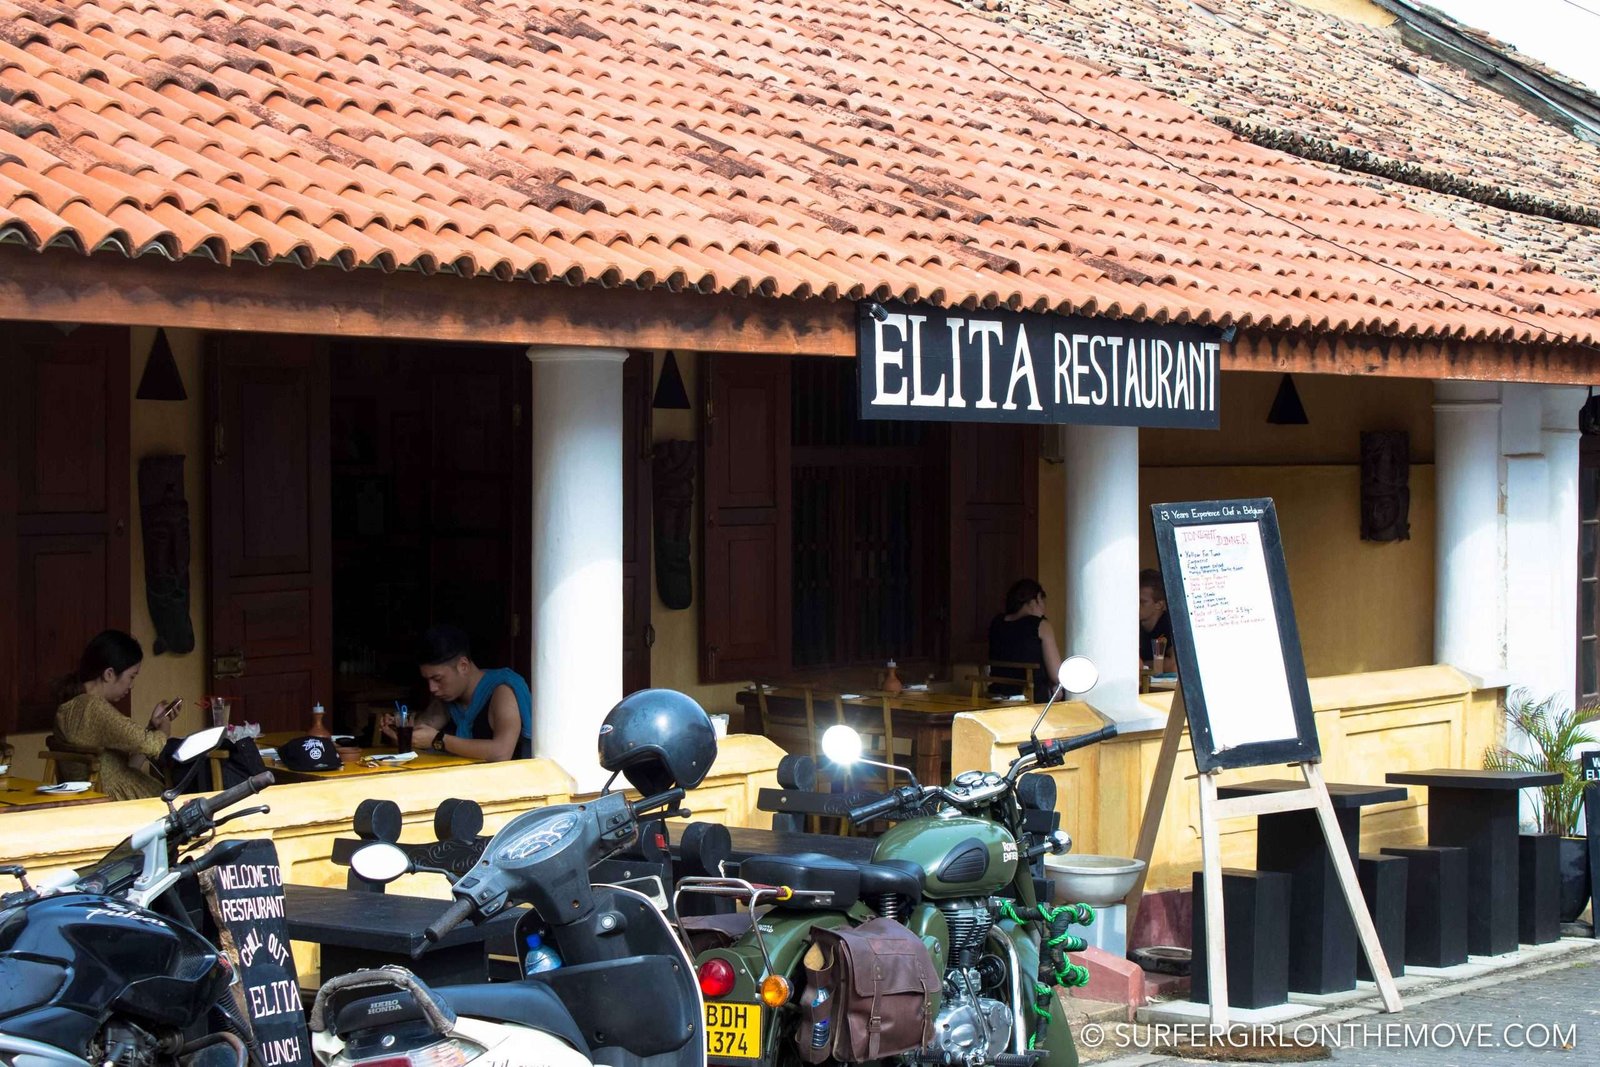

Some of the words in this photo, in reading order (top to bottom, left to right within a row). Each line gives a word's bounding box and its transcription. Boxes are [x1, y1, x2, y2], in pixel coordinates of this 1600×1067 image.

[871, 313, 1043, 411] ELITA
[1054, 332, 1220, 411] RESTAURANT
[1171, 509, 1190, 519] Years
[1190, 508, 1220, 520] Experience
[1222, 506, 1235, 516] Chef
[218, 864, 269, 890] WELCOME
[267, 865, 283, 887] TO
[222, 895, 285, 922] RESTAURANT
[241, 927, 263, 968] CHILL
[268, 933, 289, 967] OUT
[249, 979, 304, 1019] ELITA
[367, 1004, 402, 1015] HONDA
[370, 999, 399, 1009] HERO
[706, 1004, 747, 1029] BDH
[262, 1036, 302, 1067] LUNCH
[706, 1030, 748, 1055] 1374
